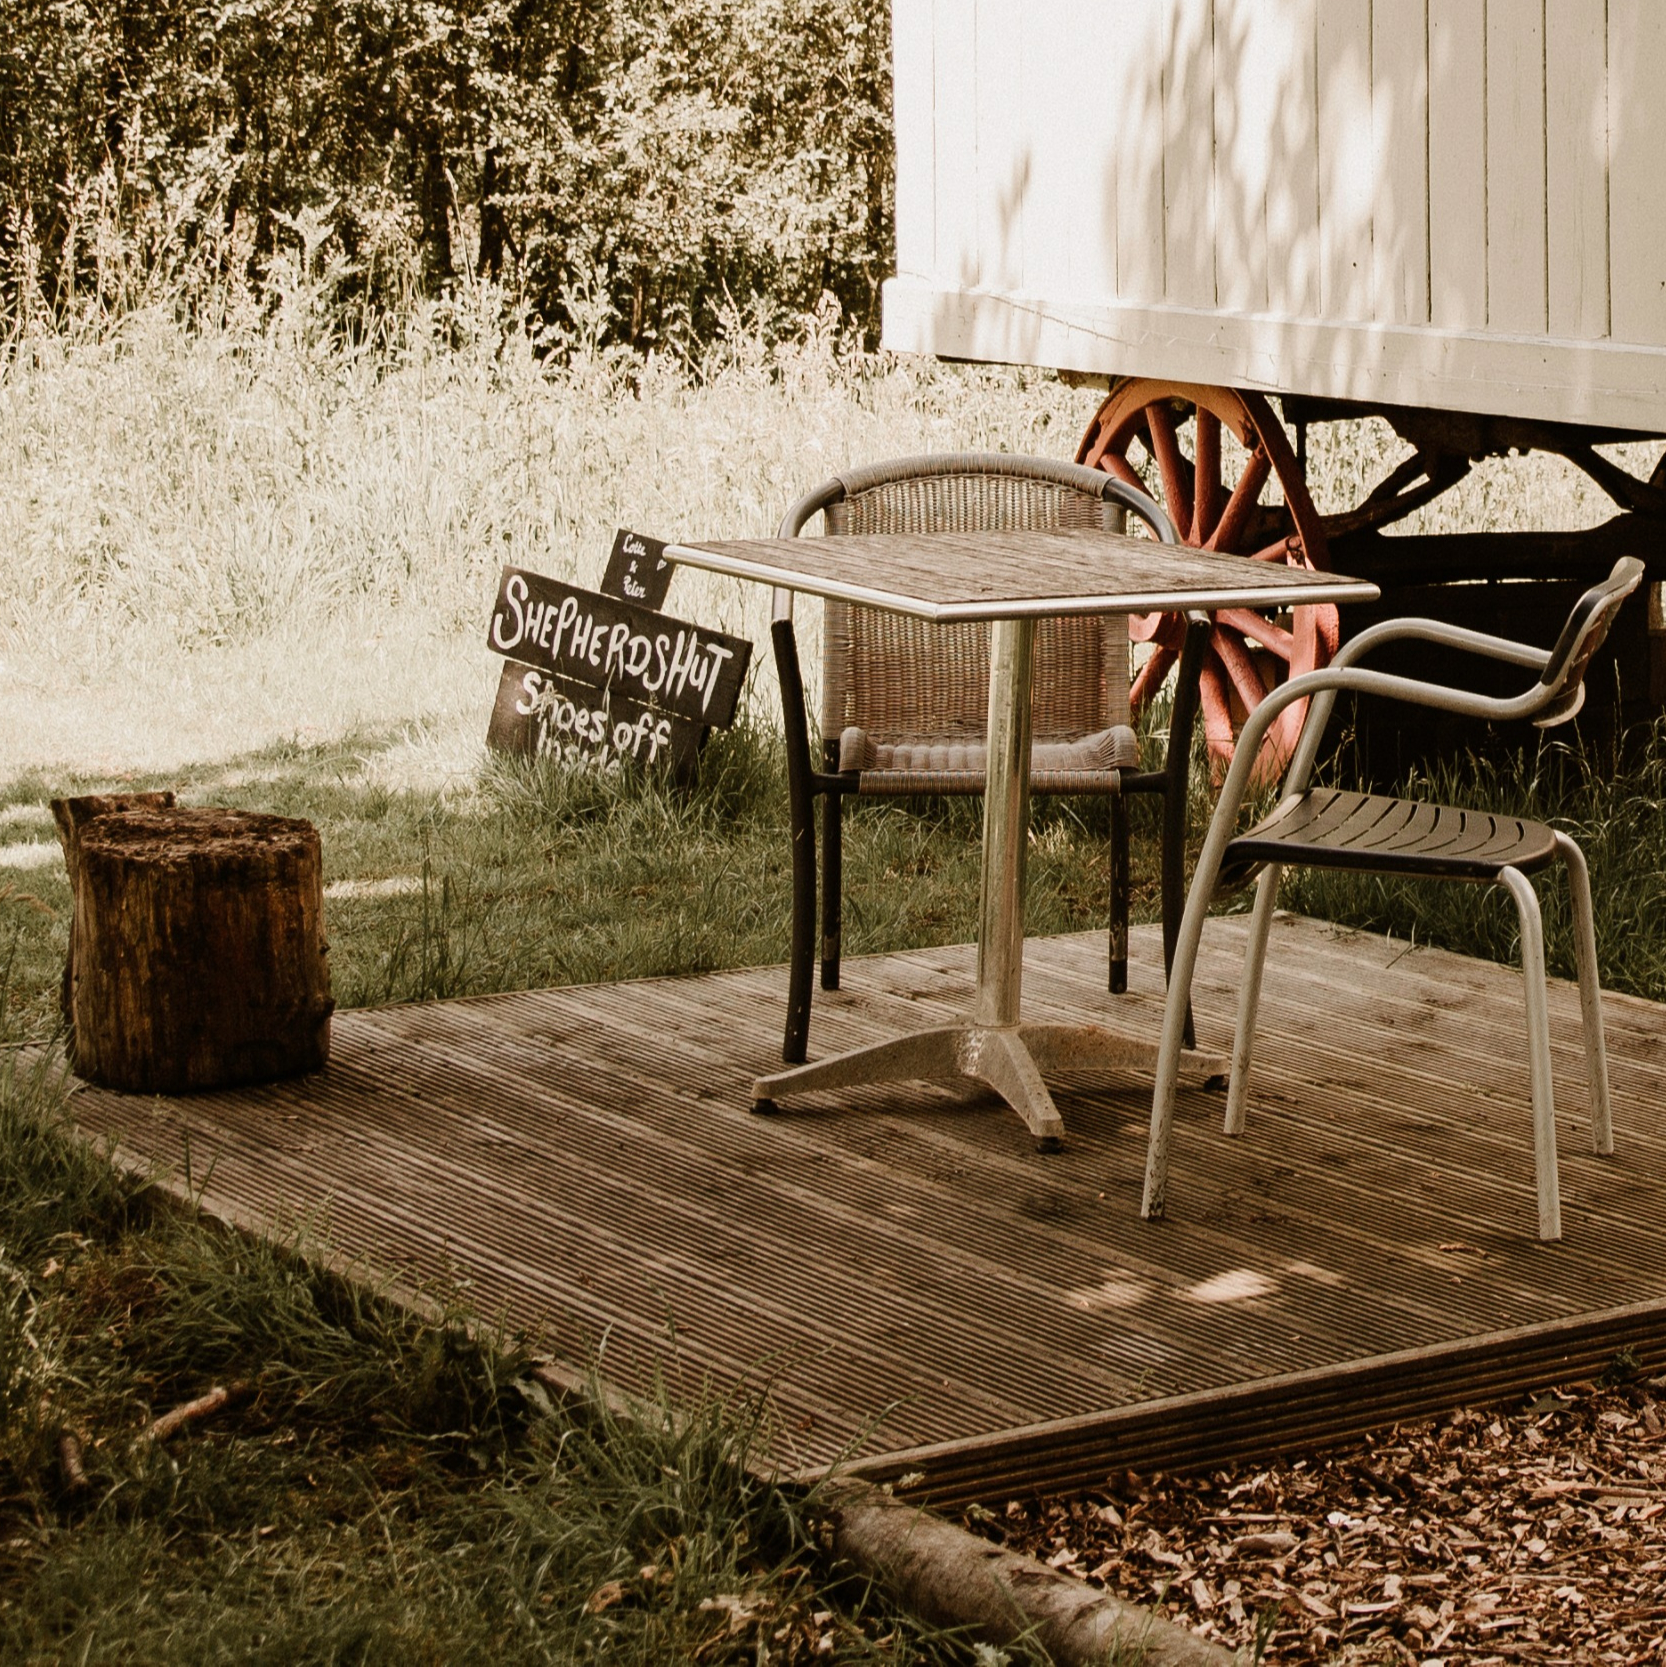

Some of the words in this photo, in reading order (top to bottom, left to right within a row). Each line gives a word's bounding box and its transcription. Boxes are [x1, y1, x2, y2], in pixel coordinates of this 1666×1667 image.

[629, 560, 638, 573] &
[623, 575, 646, 598] Peter
[516, 671, 607, 743] Shoes
[613, 712, 671, 764] off
